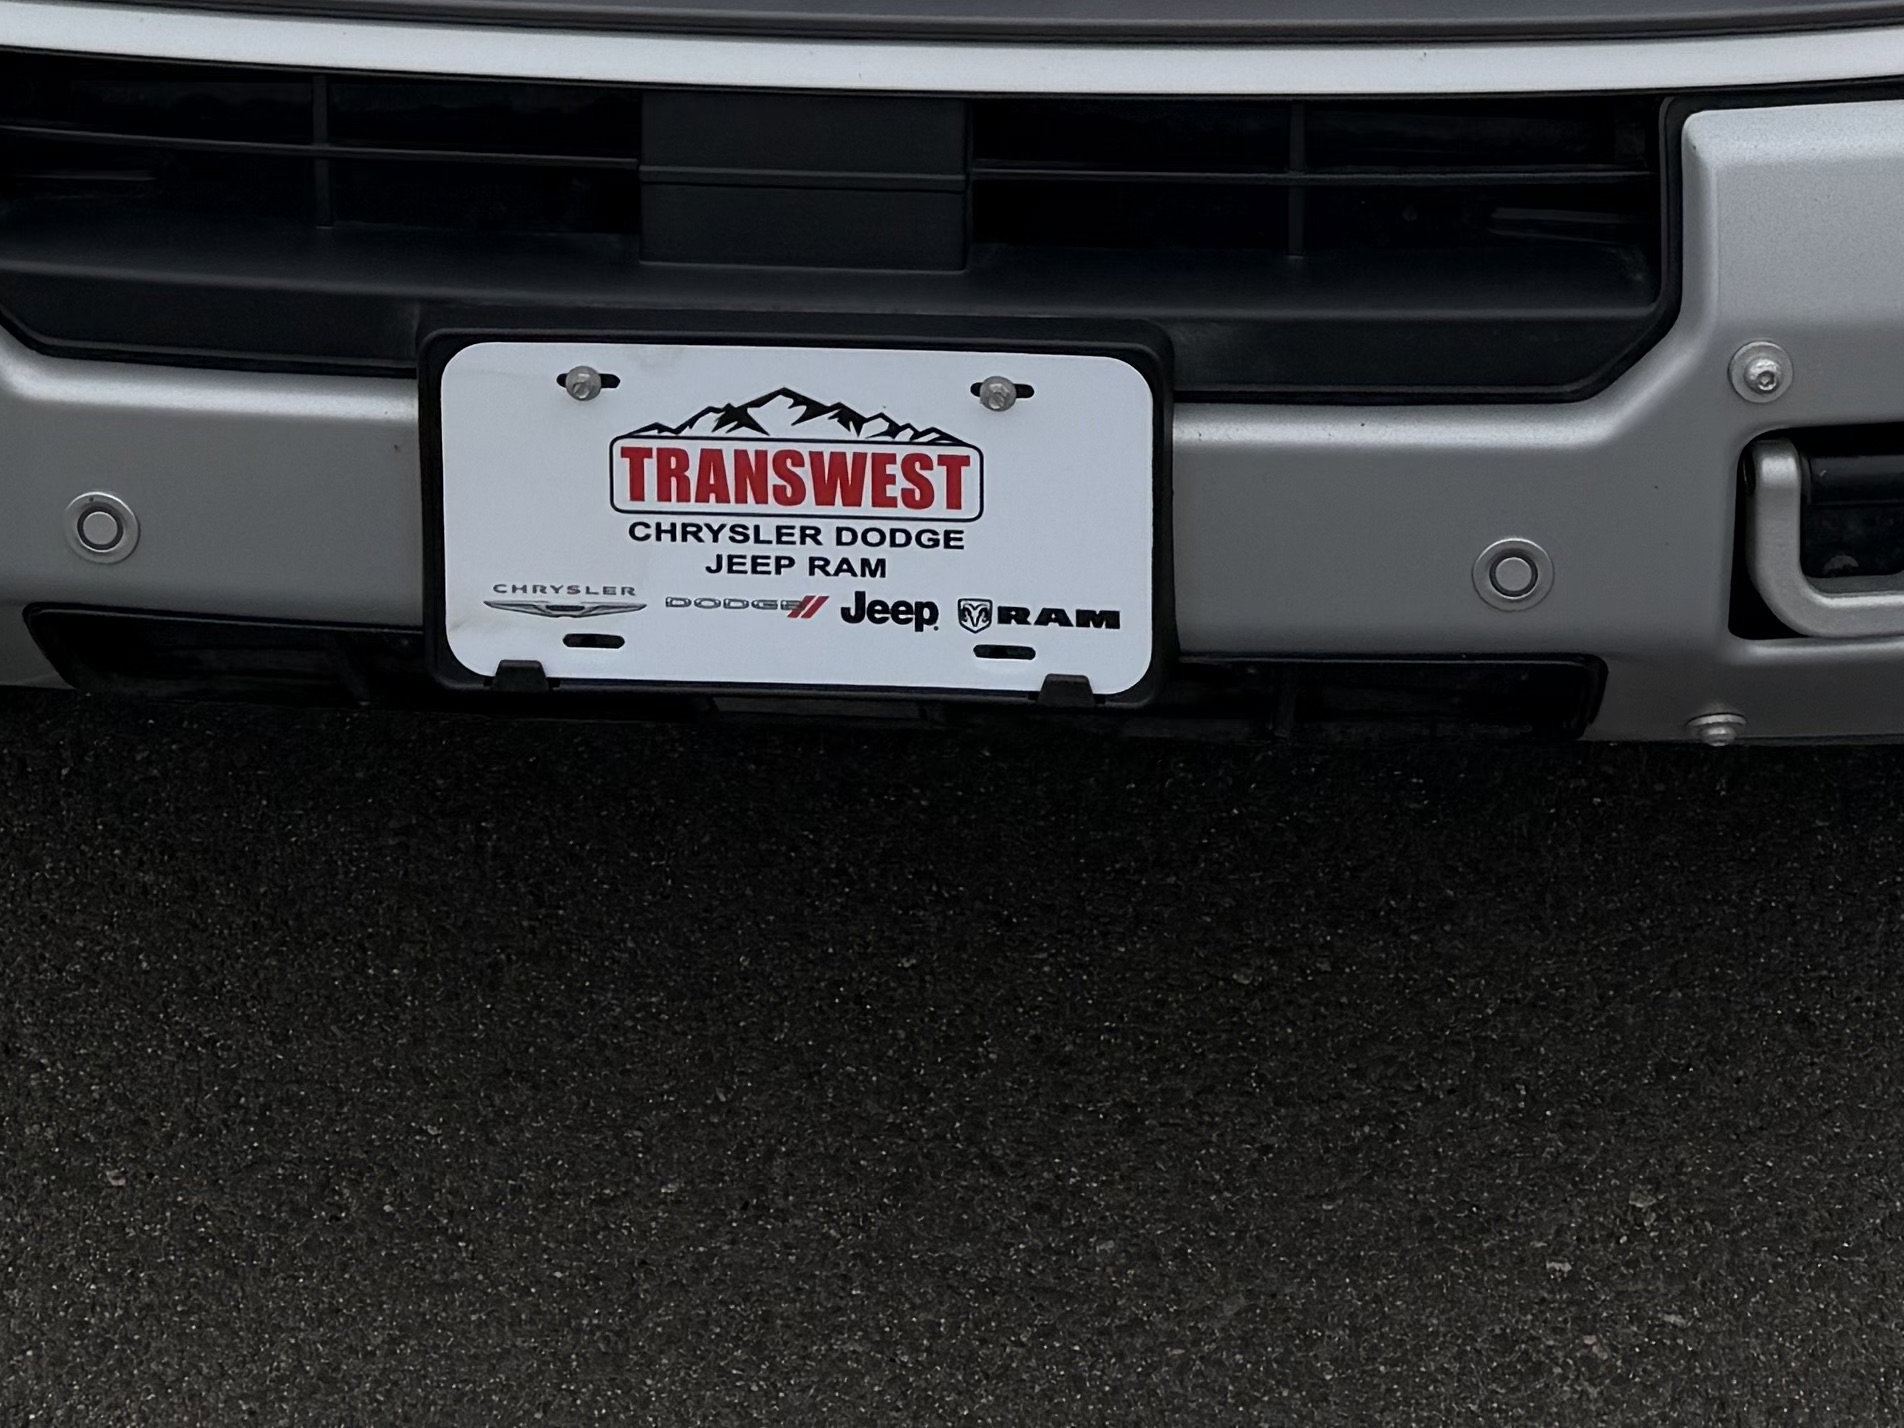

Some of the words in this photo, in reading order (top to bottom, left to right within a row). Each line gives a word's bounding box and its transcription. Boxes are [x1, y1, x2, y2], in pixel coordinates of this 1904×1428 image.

[620, 446, 971, 511] TRANSWEST
[628, 520, 823, 546] CHRYSLER
[835, 526, 966, 551] DODGE
[704, 553, 797, 576] JEEP
[808, 555, 888, 579] RAM
[492, 583, 637, 597] CHRYSLER
[664, 596, 802, 612] DODGE
[840, 590, 939, 632] Jeep
[997, 605, 1122, 631] RAM
